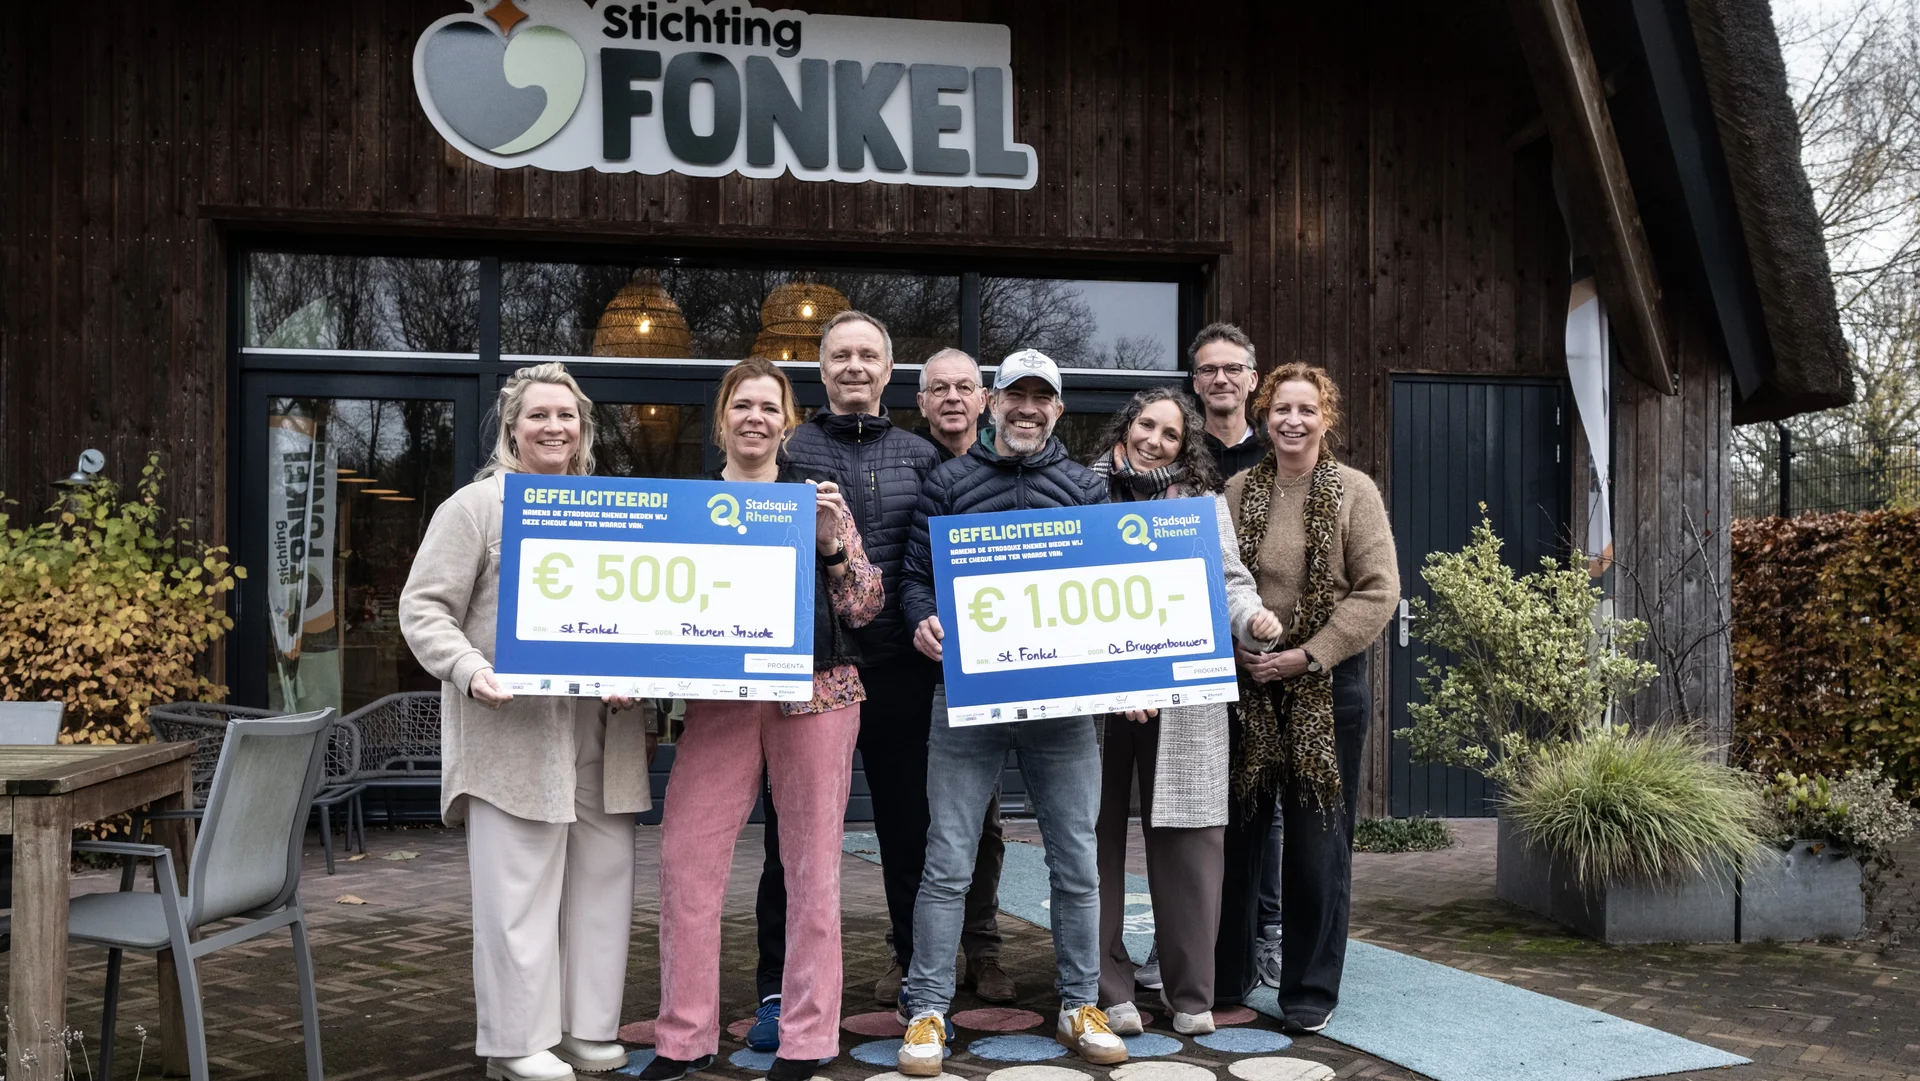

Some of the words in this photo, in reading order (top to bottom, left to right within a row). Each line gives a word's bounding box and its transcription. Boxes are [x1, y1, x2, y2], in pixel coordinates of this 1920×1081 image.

[602, 1, 802, 58] Stichting
[600, 47, 1029, 177] FONKEL
[523, 487, 669, 508] GEFELICITEERD!
[745, 498, 798, 513] Stadsquiz
[522, 509, 551, 517] NAMENS
[563, 510, 600, 518] STADSQUIZ
[745, 511, 793, 523] Rhenen
[1152, 513, 1201, 527] Stadsquiz
[522, 518, 540, 526] DEZE
[541, 519, 567, 527] CHEQUE
[599, 521, 627, 529] WAARDE
[948, 519, 1081, 544] GEFELICITEERD!
[1153, 527, 1198, 539] Rhenen
[950, 547, 977, 556] NAMENS
[987, 544, 1022, 553] STADSQUIZ
[1022, 542, 1047, 550] RHENEN
[1048, 540, 1071, 548] BIEDEN
[951, 557, 968, 565] DEZE
[968, 556, 993, 564] CHEQUE
[994, 554, 1007, 562] AAN
[1008, 553, 1021, 561] TER
[1021, 551, 1048, 560] WAARDE
[532, 552, 575, 600] €
[595, 554, 732, 614] 500,-
[968, 586, 1008, 633] €
[1023, 574, 1186, 628] 1.000,-
[577, 621, 620, 635] Fonkel
[680, 622, 725, 638] Rhenen
[1018, 646, 1058, 662] Fonkel
[1108, 643, 1125, 655] De
[767, 662, 805, 670] PROGENTA
[1193, 666, 1229, 675] PROGENTA
